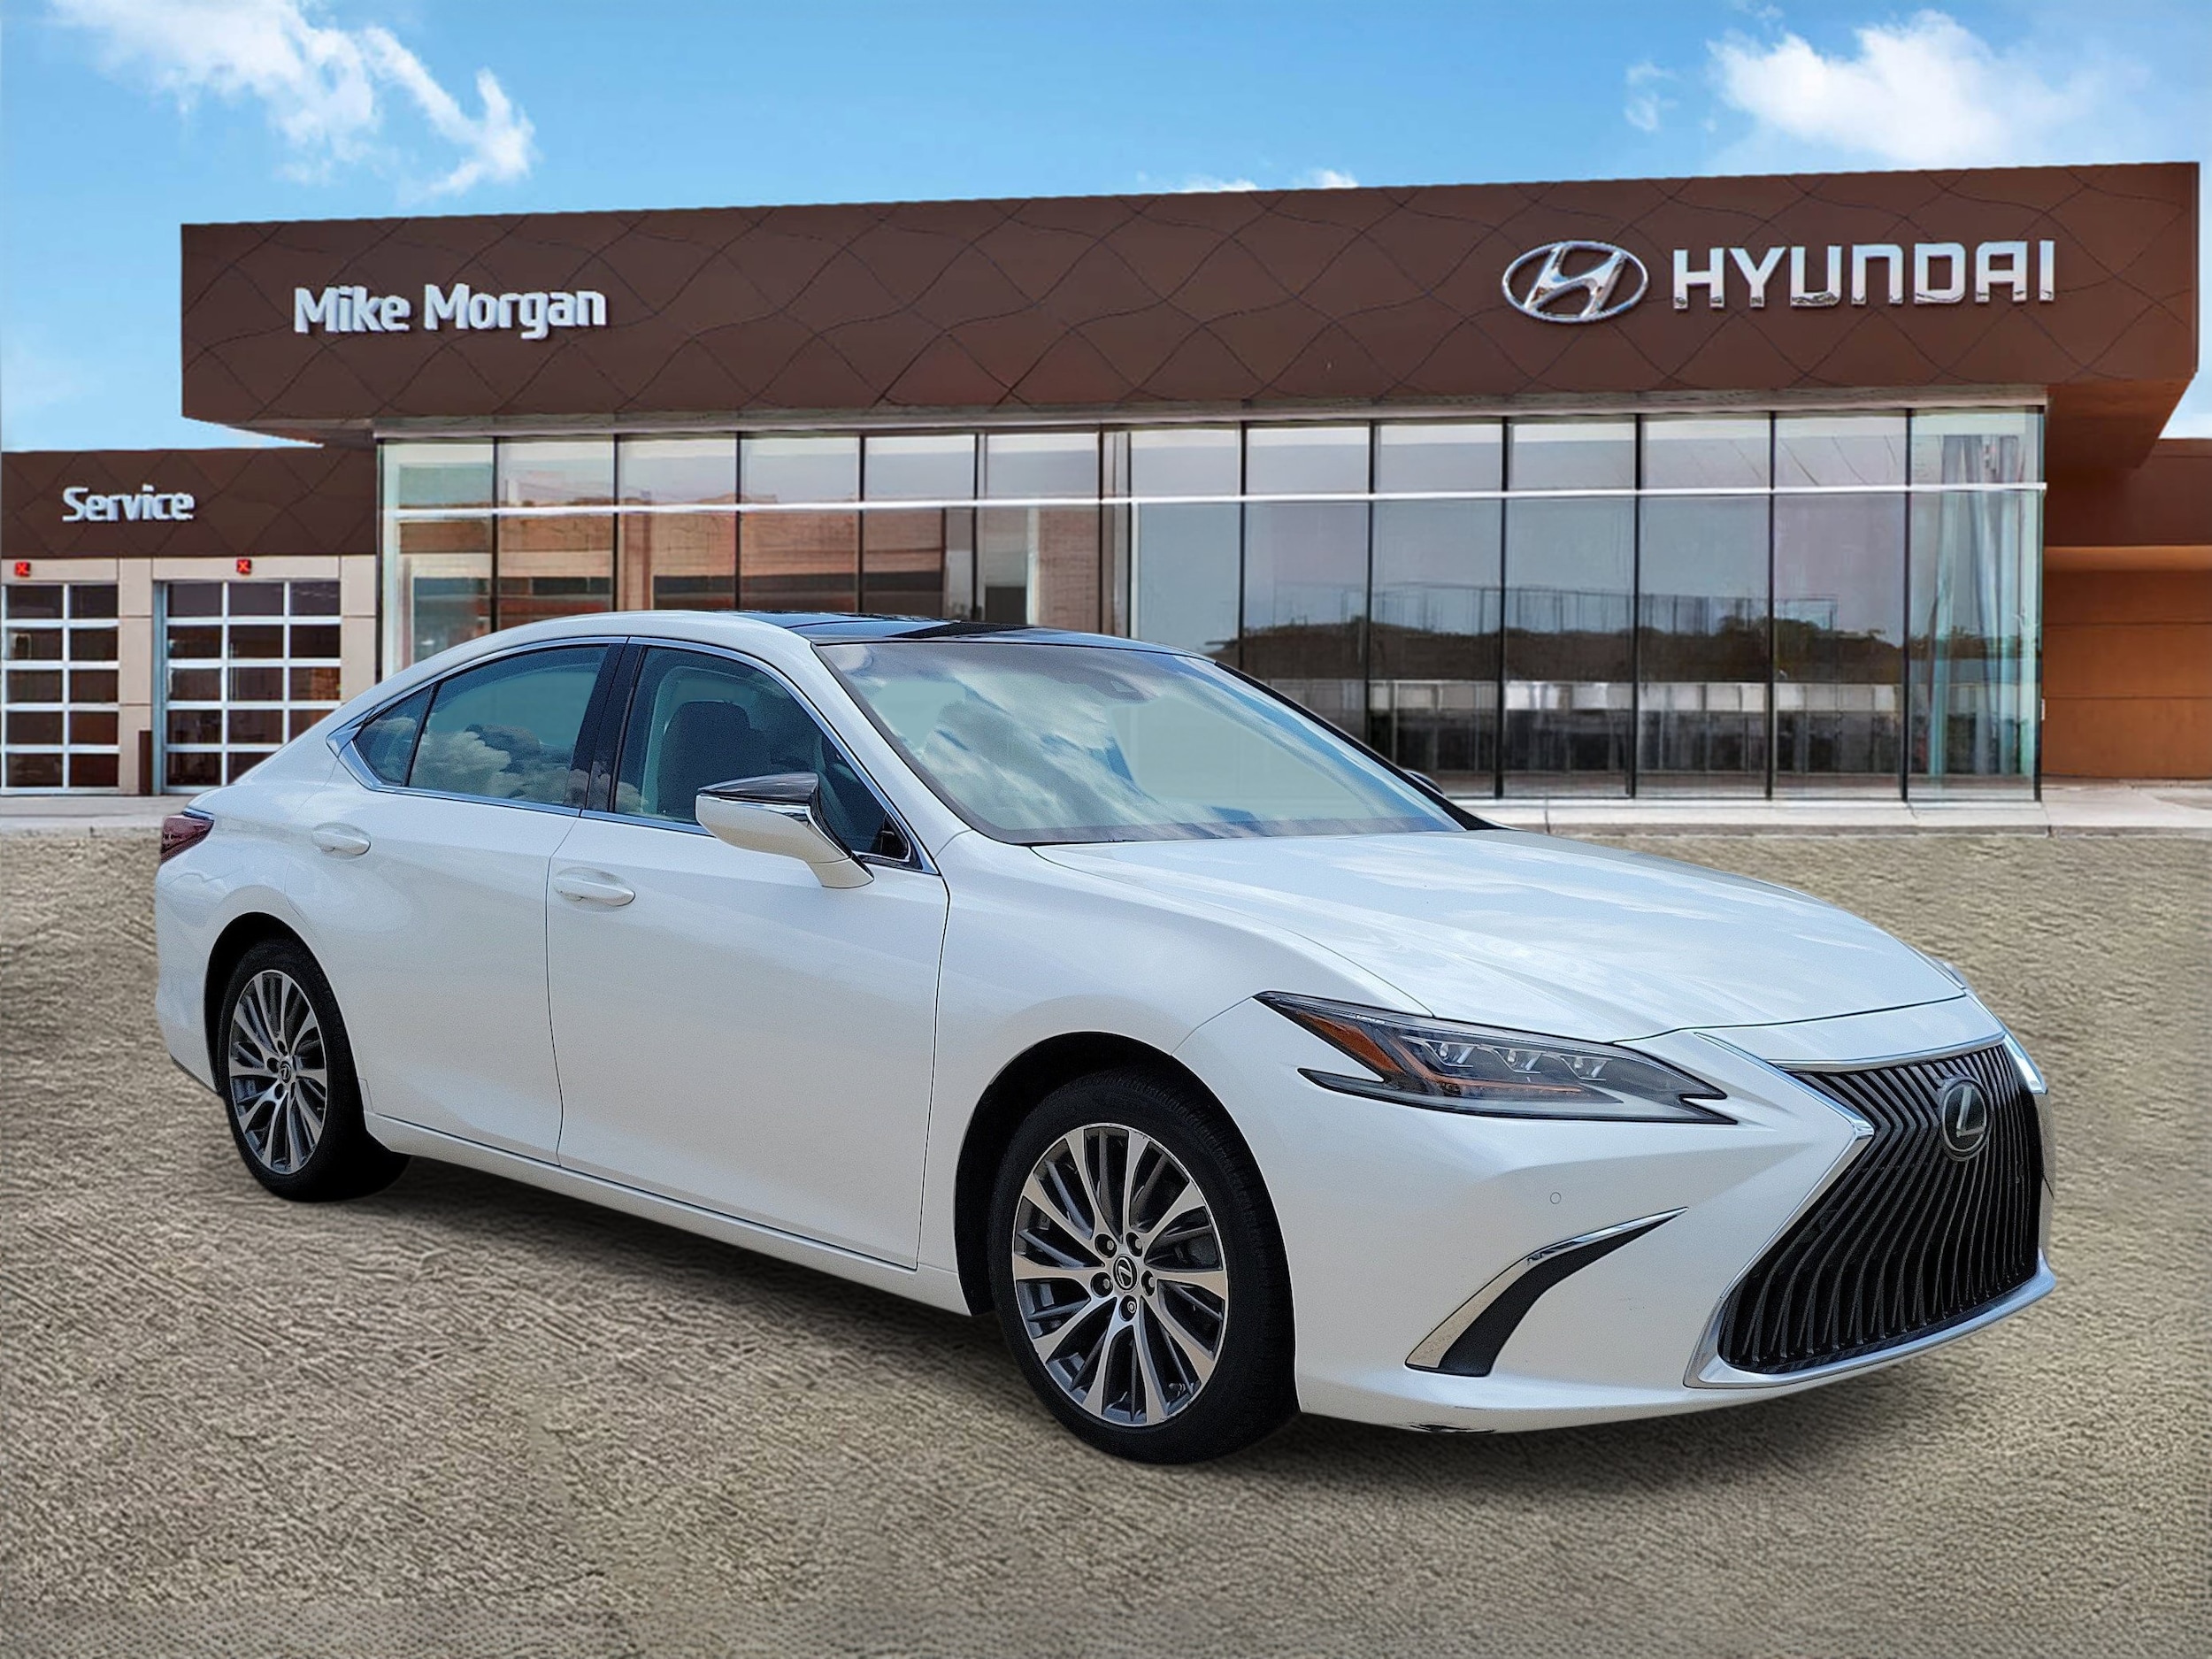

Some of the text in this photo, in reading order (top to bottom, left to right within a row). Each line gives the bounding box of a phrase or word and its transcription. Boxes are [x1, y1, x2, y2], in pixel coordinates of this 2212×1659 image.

[1673, 240, 2055, 309] HYUNDAI
[294, 283, 607, 340] Mike Morgan
[62, 484, 195, 522] Service
